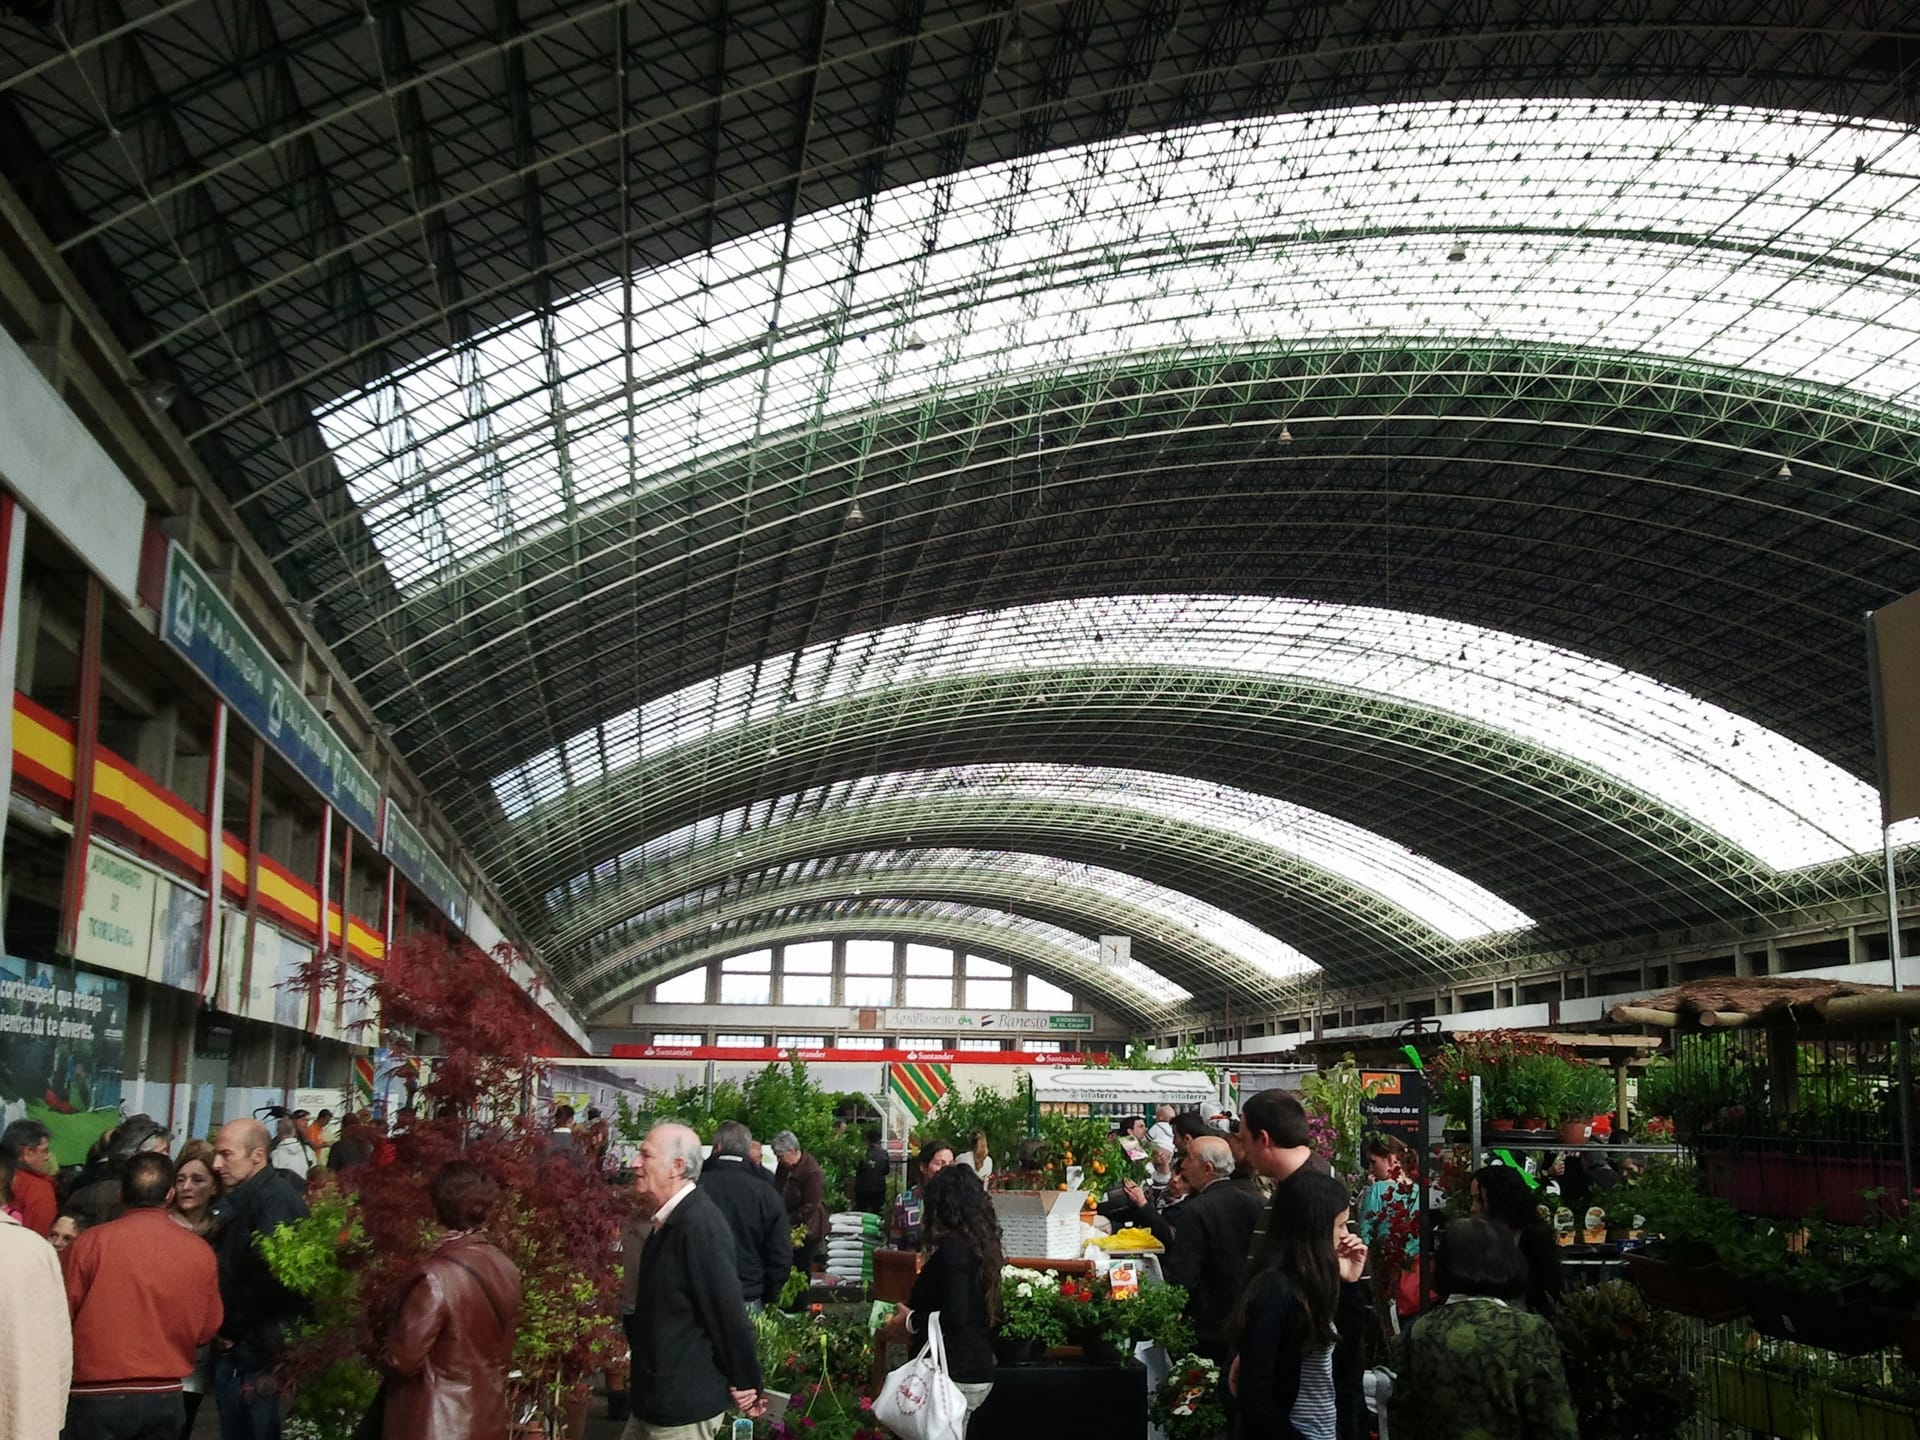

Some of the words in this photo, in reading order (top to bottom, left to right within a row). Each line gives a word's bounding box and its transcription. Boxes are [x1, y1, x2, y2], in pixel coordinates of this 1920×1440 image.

[57, 990, 73, 1012] que
[46, 1016, 58, 1036] te
[998, 1013, 1048, 1030] Banesto
[656, 1047, 694, 1057] Santander
[796, 1048, 827, 1059] ntander
[918, 1051, 954, 1061] Santander
[1046, 1054, 1081, 1063] Santander
[1080, 1091, 1118, 1099] vitaterra
[1170, 1091, 1207, 1100] vitaterra
[1401, 1106, 1411, 1114] de
